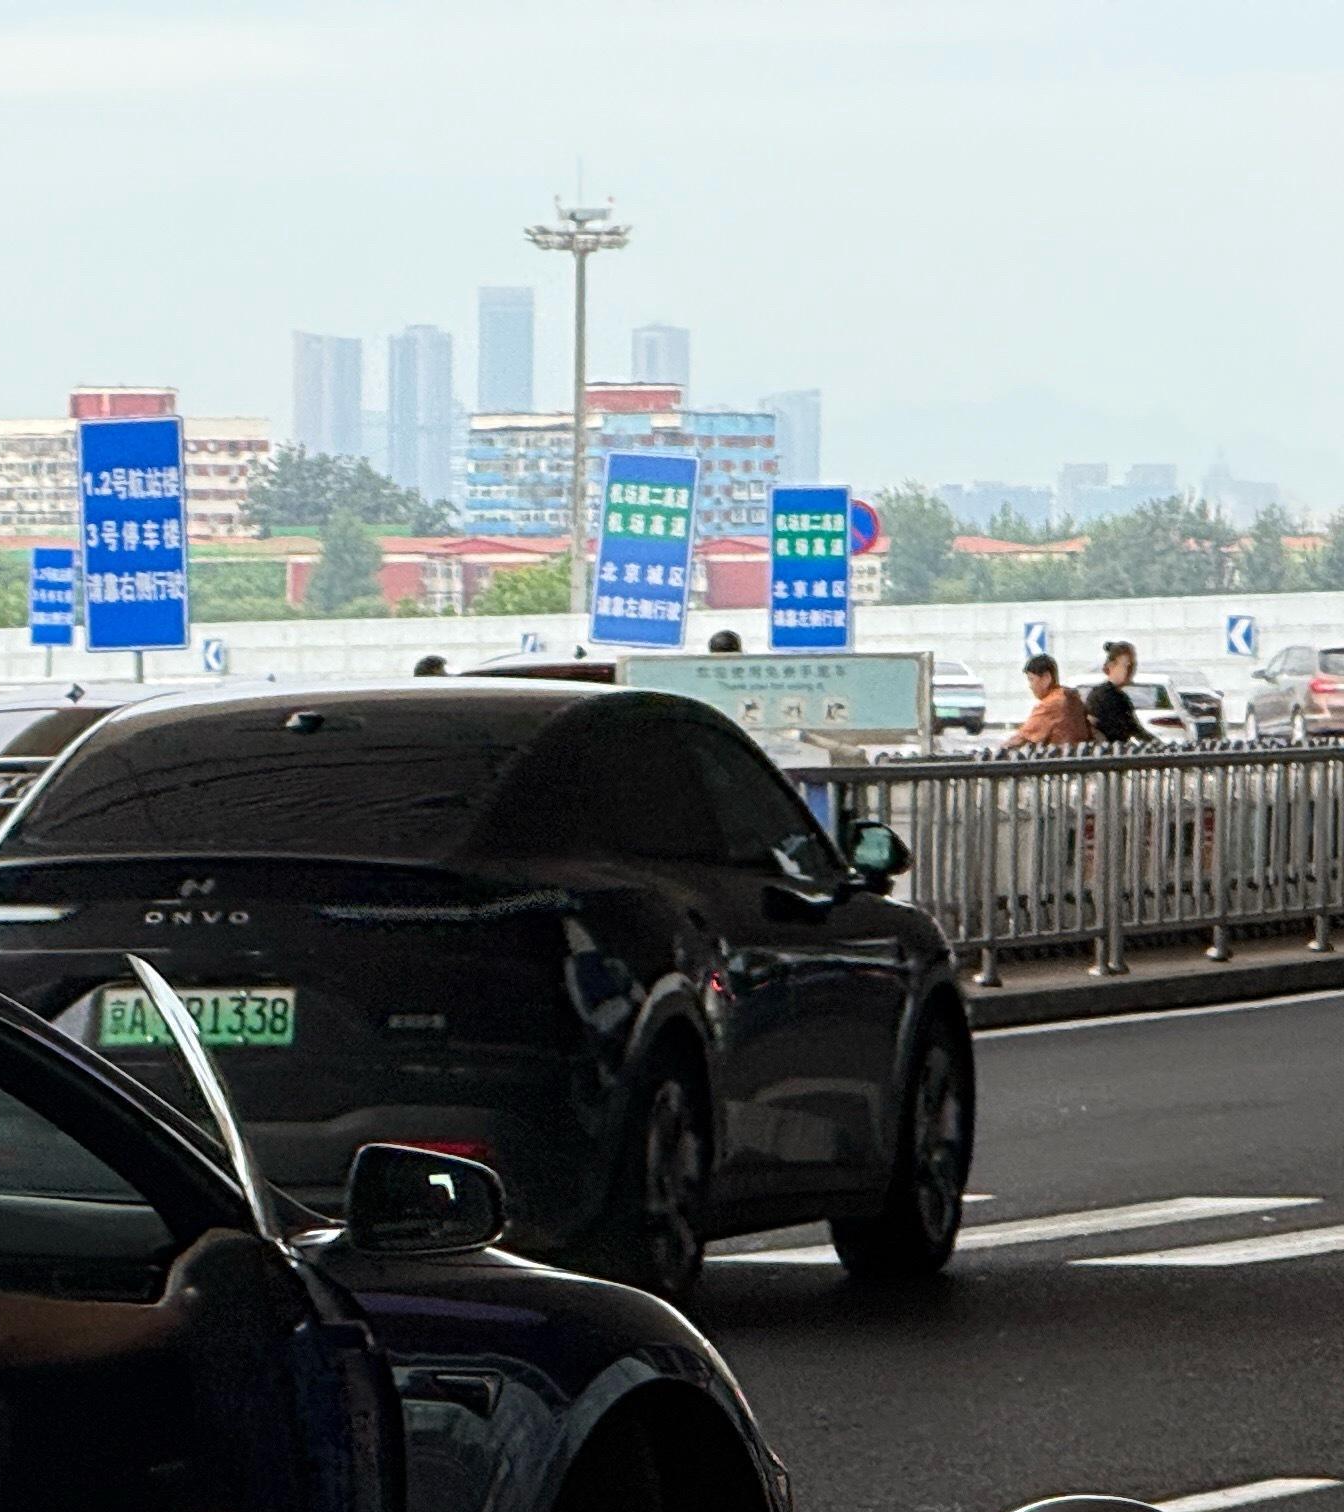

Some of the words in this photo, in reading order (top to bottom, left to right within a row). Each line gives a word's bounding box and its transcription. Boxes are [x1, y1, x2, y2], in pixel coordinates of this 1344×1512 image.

[87, 519, 181, 550] 3号停车楼
[600, 561, 684, 588] 北京城区
[145, 911, 249, 924] ONVO
